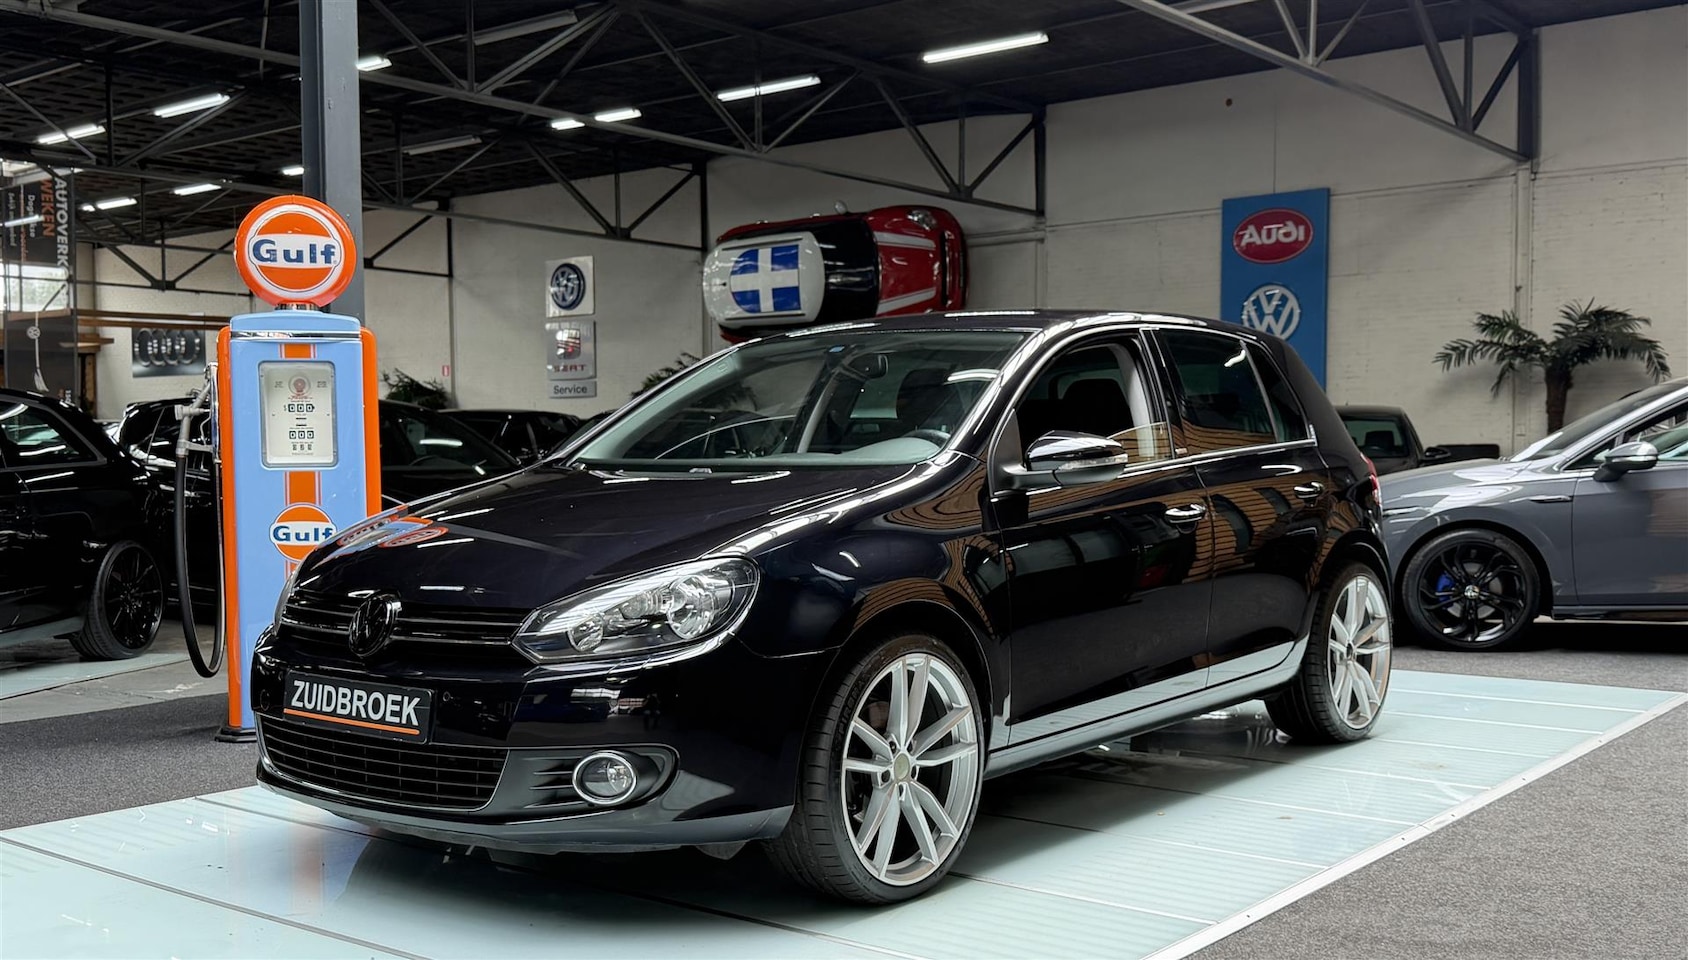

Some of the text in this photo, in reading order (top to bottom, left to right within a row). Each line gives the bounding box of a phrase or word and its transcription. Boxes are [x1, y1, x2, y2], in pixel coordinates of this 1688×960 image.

[26, 194, 36, 238] Dagekse
[41, 179, 55, 237] WEKEN
[252, 239, 336, 265] Gulf
[553, 384, 588, 394] Service
[273, 525, 333, 542] Gulf
[291, 681, 421, 726] ZUIDBROEK
